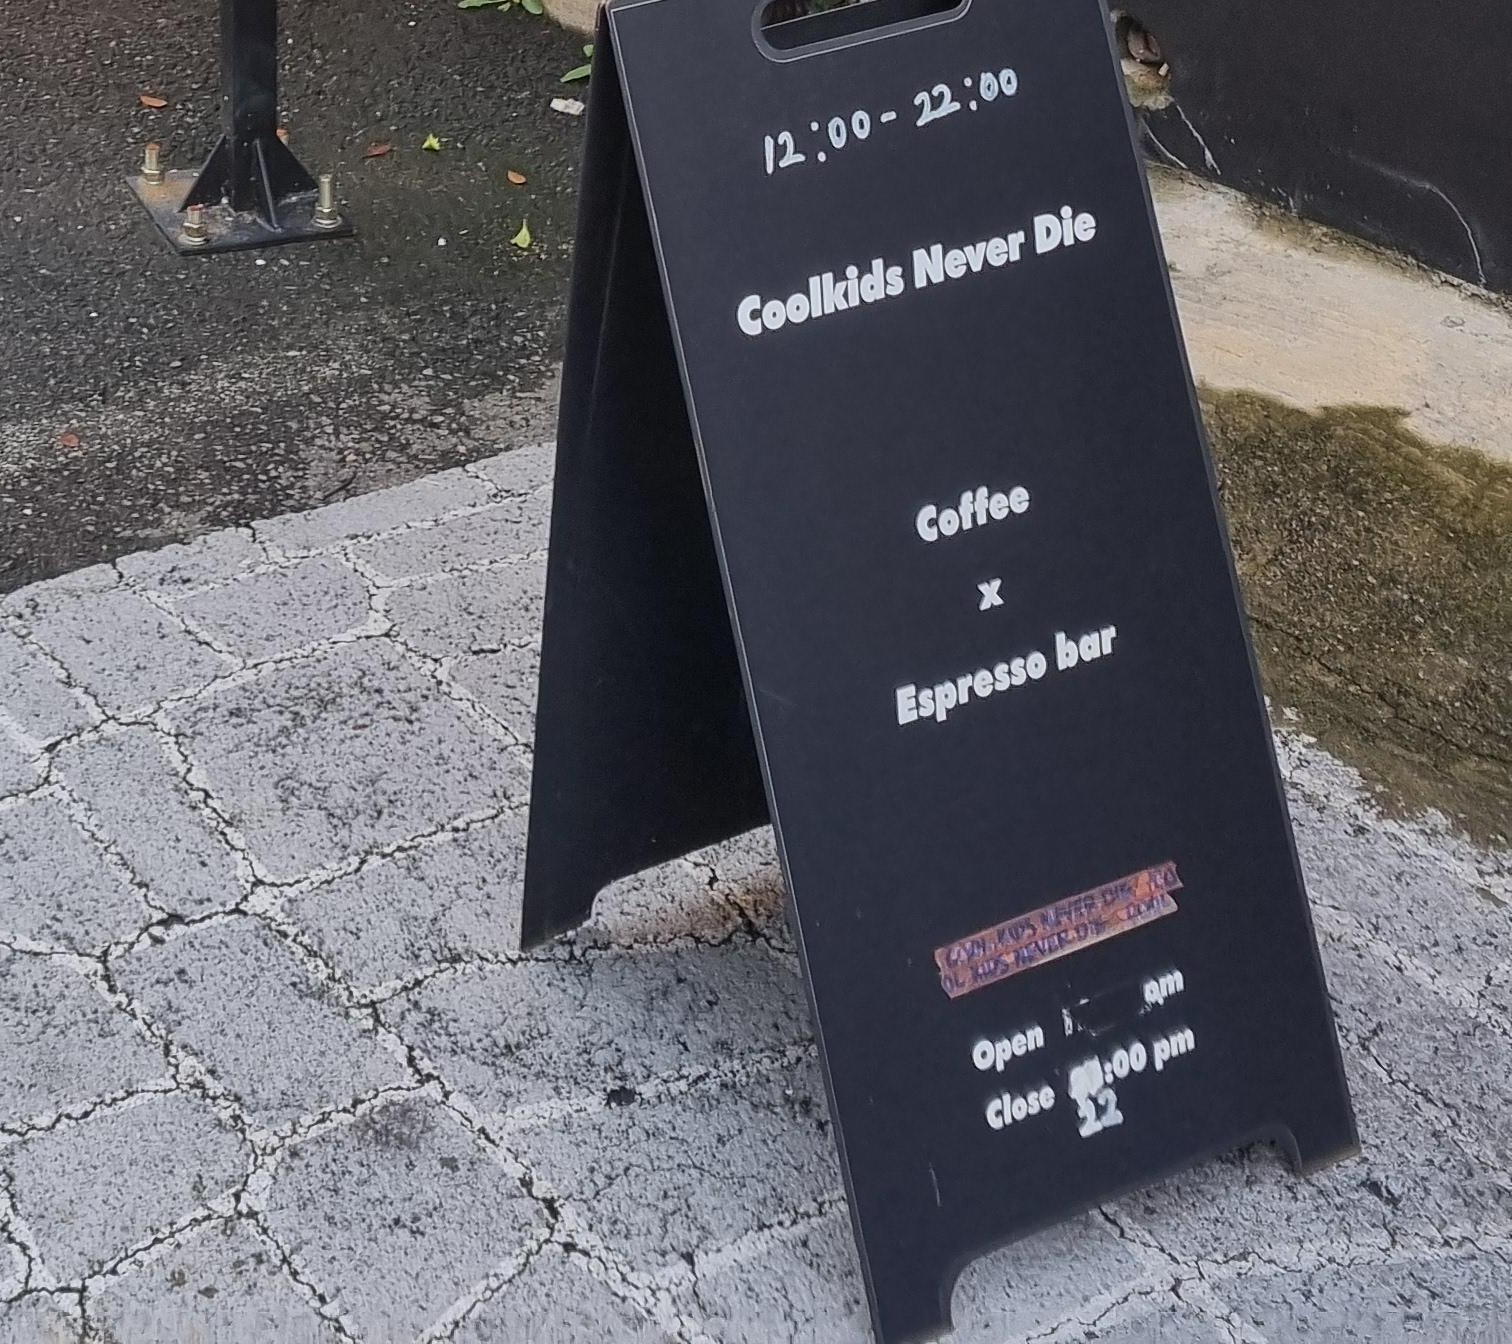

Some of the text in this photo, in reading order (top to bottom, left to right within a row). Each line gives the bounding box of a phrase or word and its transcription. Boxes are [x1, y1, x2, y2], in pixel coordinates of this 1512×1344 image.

[913, 68, 1018, 127] 22:00
[737, 205, 1097, 336] Coolkids Never Die
[916, 484, 1030, 542] Coffee
[896, 625, 1117, 726] Espresso bar
[972, 970, 1184, 1072] Open am
[986, 1085, 1056, 1130] Close
[1152, 1027, 1195, 1071] pm
